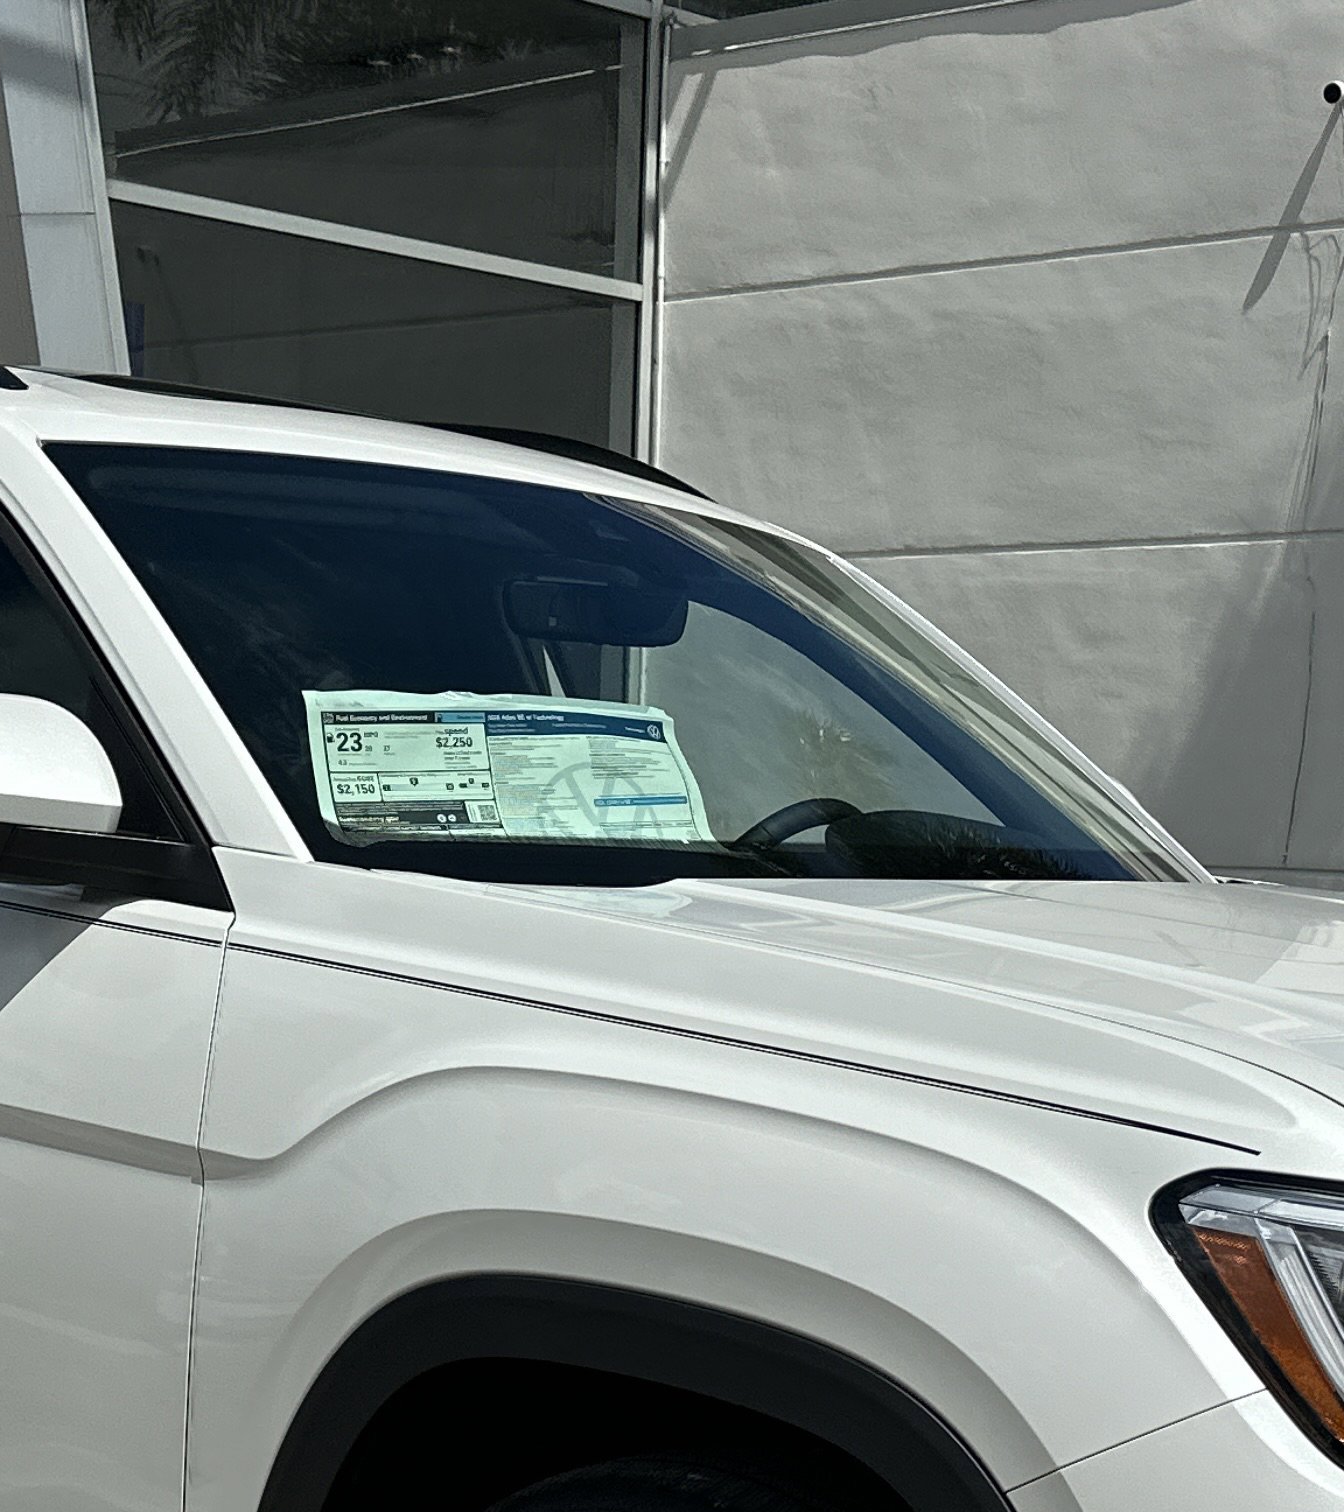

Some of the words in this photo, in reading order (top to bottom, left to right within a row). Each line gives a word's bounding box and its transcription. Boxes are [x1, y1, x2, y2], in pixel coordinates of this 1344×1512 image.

[336, 732, 363, 752] 23
[435, 736, 473, 750] $2,250
[337, 784, 375, 796] $2,150
